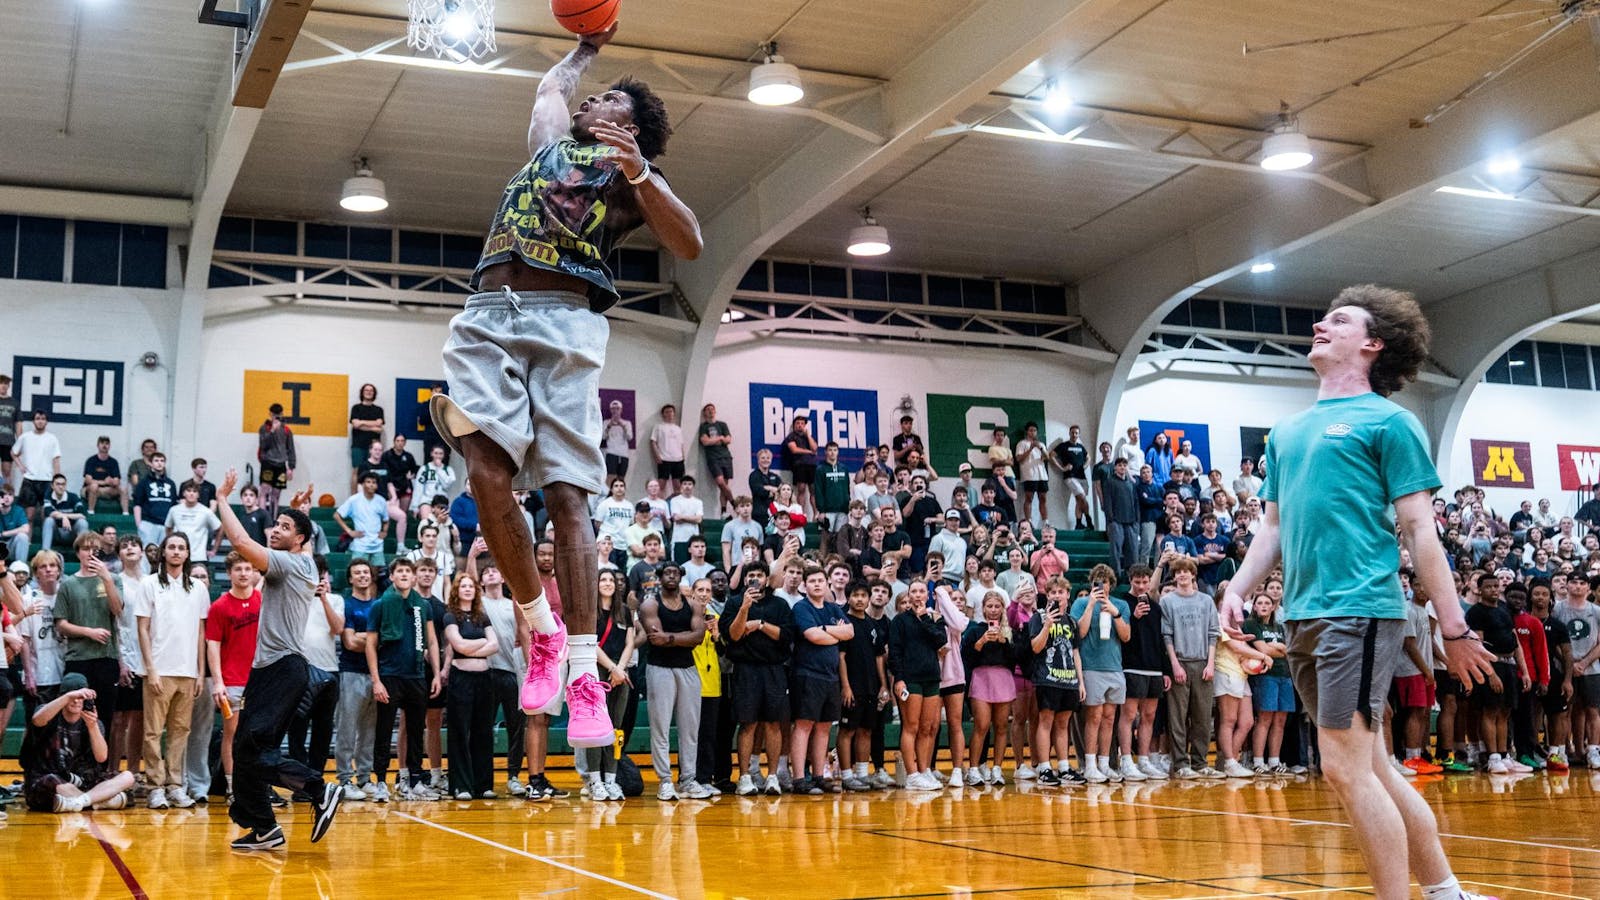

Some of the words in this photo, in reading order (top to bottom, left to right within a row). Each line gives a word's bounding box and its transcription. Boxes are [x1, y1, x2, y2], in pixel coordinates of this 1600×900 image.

[21, 365, 115, 416] PSU
[281, 381, 311, 425] I
[965, 406, 1011, 469] S
[1482, 445, 1525, 482] M
[1570, 451, 1600, 486] W
